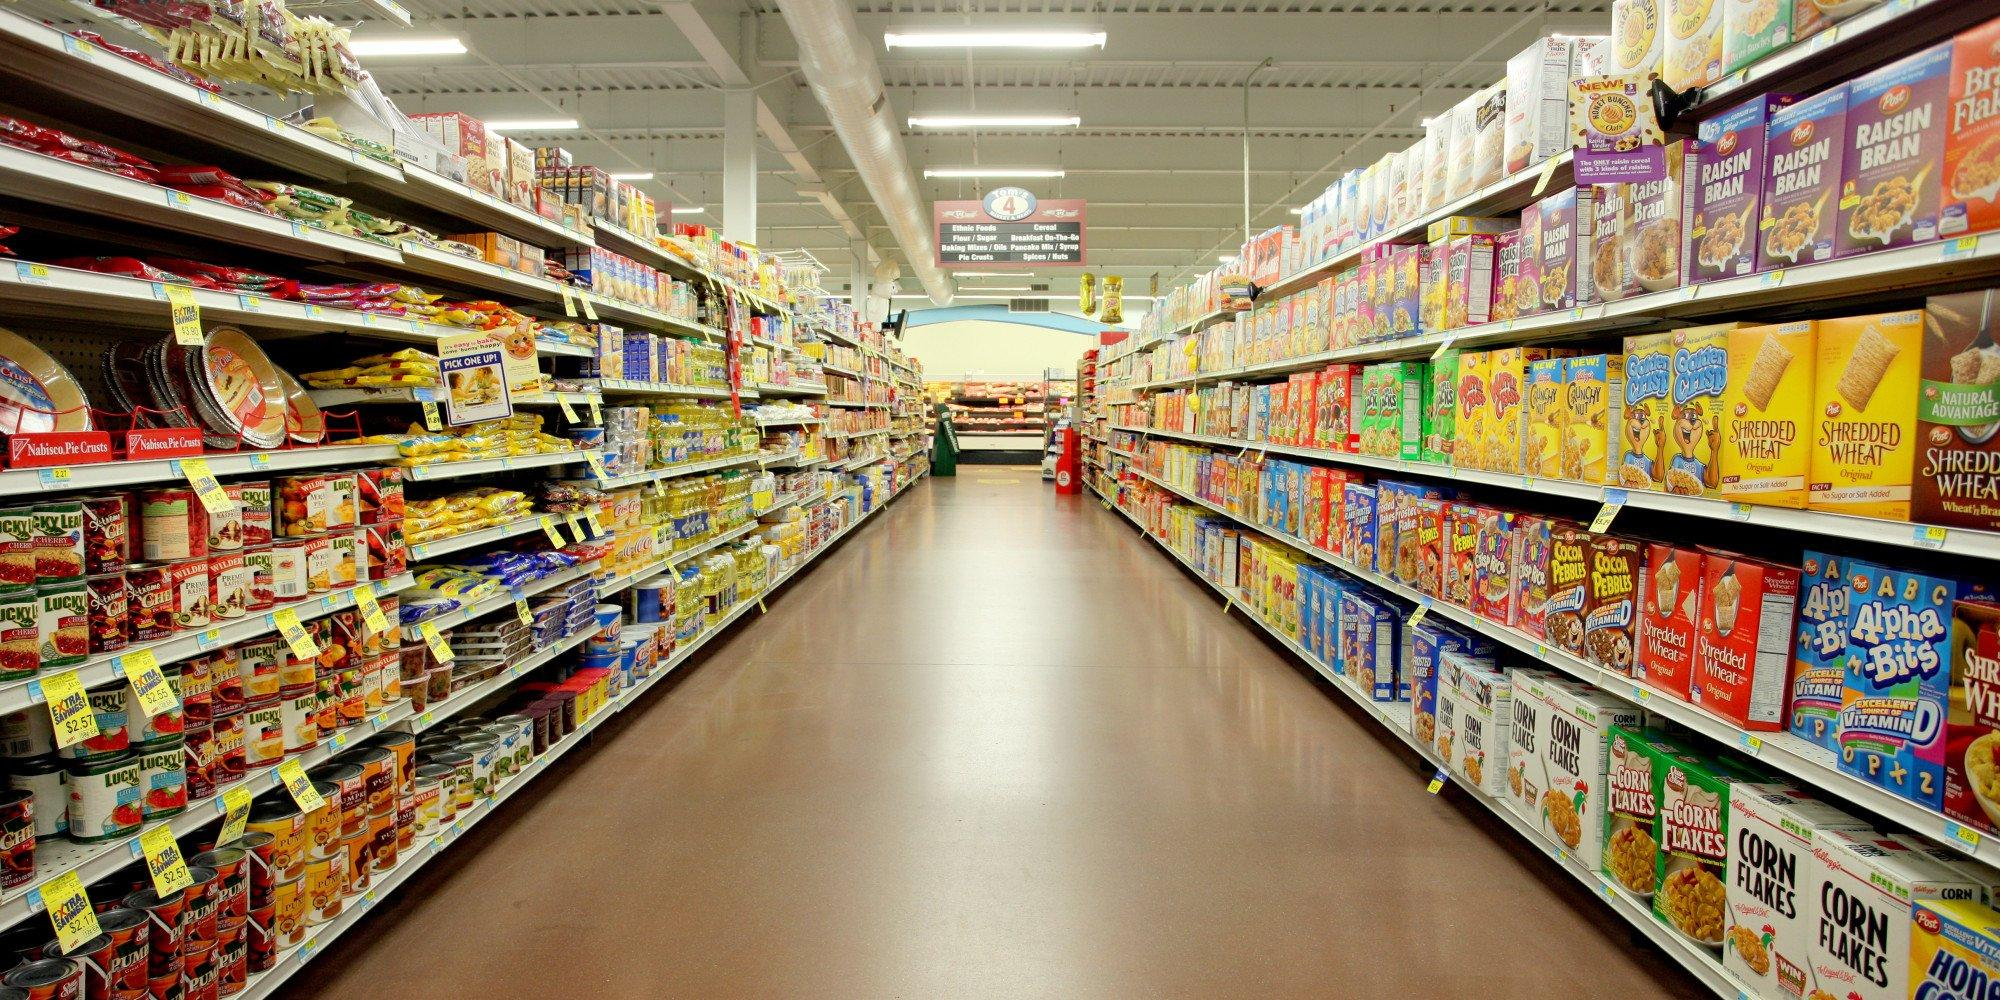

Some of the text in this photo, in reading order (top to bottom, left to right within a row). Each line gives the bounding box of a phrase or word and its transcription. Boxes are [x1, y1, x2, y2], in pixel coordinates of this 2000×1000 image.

[1571, 78, 1587, 88] TRY
[1579, 79, 1624, 92] NEW!
[1592, 98, 1606, 119] HONEY
[1882, 88, 1906, 110] Post
[1605, 123, 1623, 132] Oats
[1793, 124, 1811, 143] Post
[1856, 102, 1932, 149] RAISIN
[1773, 137, 1830, 177] RAISIN
[1860, 133, 1920, 171] BRAN
[1701, 147, 1752, 186] RAISIN
[1630, 178, 1672, 204] Raisin
[1705, 174, 1744, 205] BRAN
[1776, 164, 1820, 196] BRAN
[1003, 196, 1016, 214] 4
[1634, 198, 1665, 223] Bran
[952, 224, 996, 232] Ethnic Foods
[977, 234, 997, 243] Sugar
[1544, 222, 1570, 244] RAISIN
[942, 244, 966, 252] Baking
[1023, 253, 1046, 261] Spices
[1060, 243, 1079, 252] Syrup
[1545, 242, 1566, 261] BRAN
[173, 306, 196, 317] EXTRA
[444, 353, 498, 369] PICK ONE UP!
[1533, 360, 1556, 371] NEW!
[1571, 357, 1600, 369] NEW!
[1530, 385, 1557, 409] CRUNCHY
[1568, 383, 1601, 410] CRUNCHY
[1942, 390, 1994, 405] NATURAL
[1535, 404, 1547, 415] NUT
[1575, 403, 1589, 415] NUT
[1931, 402, 2000, 419] ADVANTAGE
[140, 433, 201, 450] Nabisco Pie Crusts
[1729, 420, 1796, 443] SHREDDED
[1819, 420, 1901, 447] SHREDDED
[27, 440, 108, 456] Nabisco Pie Crusts
[1738, 440, 1792, 460] WHEAT
[1830, 442, 1896, 466] WHEAT
[1746, 462, 1774, 474] Original
[1840, 469, 1873, 482] Original
[1822, 491, 1830, 499] No
[1829, 491, 1844, 501] Sugar
[1855, 490, 1867, 498] Salt
[1868, 489, 1890, 498] Added
[1553, 541, 1584, 562] COCOA
[1551, 559, 1587, 586] PEBBLES
[1594, 551, 1629, 575] COCOA
[1825, 560, 1840, 579] A
[1591, 571, 1633, 599] PEBBLES
[1764, 575, 1795, 587] Shredded
[1768, 582, 1790, 590] Wheat
[1852, 578, 1868, 591] Post
[1877, 575, 1948, 605] A B C
[44, 595, 84, 613] LUCKY
[1586, 600, 1632, 631] VITAMIN D
[1850, 600, 1947, 646] Alpha
[1644, 617, 1686, 648] Shredded
[1647, 637, 1679, 663] Wheat
[1699, 635, 1747, 671] Shredded
[1650, 660, 1674, 677] Original
[1704, 655, 1738, 685] Wheat
[1864, 640, 1940, 683] -Bits
[132, 668, 158, 688] EXTRA
[137, 674, 164, 698] SAVINGS!
[147, 688, 168, 704] $2.55
[1706, 681, 1732, 702] Original
[52, 692, 82, 717] EXTRA
[54, 698, 86, 726] SAVINGS!
[1440, 695, 1454, 716] CORN
[1513, 697, 1536, 733] CORN
[1855, 699, 1917, 711] EXCELLENT
[1862, 708, 1902, 716] SOURCE OF
[66, 714, 94, 734] $2.57
[1439, 709, 1453, 730] FLAKES
[1465, 713, 1482, 736] CORN
[1614, 713, 1636, 724] CORN
[1842, 699, 1940, 742] VITAMIN D
[1464, 729, 1481, 751] FLAKES
[1511, 721, 1535, 754] FLAKES
[1551, 714, 1581, 755] CORN
[139, 753, 178, 771] LUCKY
[1550, 739, 1580, 777] FLAKES
[104, 766, 140, 788] LUCKY
[1616, 764, 1650, 795] CORN
[1607, 773, 1656, 817] FLAKES
[1673, 799, 1718, 832] CORN
[1731, 798, 1757, 819] Kellogg's
[1660, 808, 1726, 857] FLAKES
[149, 846, 175, 869] EXTRA
[152, 850, 180, 877] SAVINGS!
[1738, 828, 1797, 890] CORN
[1812, 847, 1841, 871] Kellogg's
[163, 865, 187, 884] $2.57
[1737, 860, 1797, 920] FLAKES
[1941, 887, 1973, 900] CORN
[52, 892, 81, 922] EXTRA
[56, 896, 87, 932] SAVINGS!
[1821, 880, 1889, 955] CORN
[70, 912, 95, 934] $2.17
[1919, 913, 1938, 929] Post
[1819, 916, 1889, 988] FLAKES
